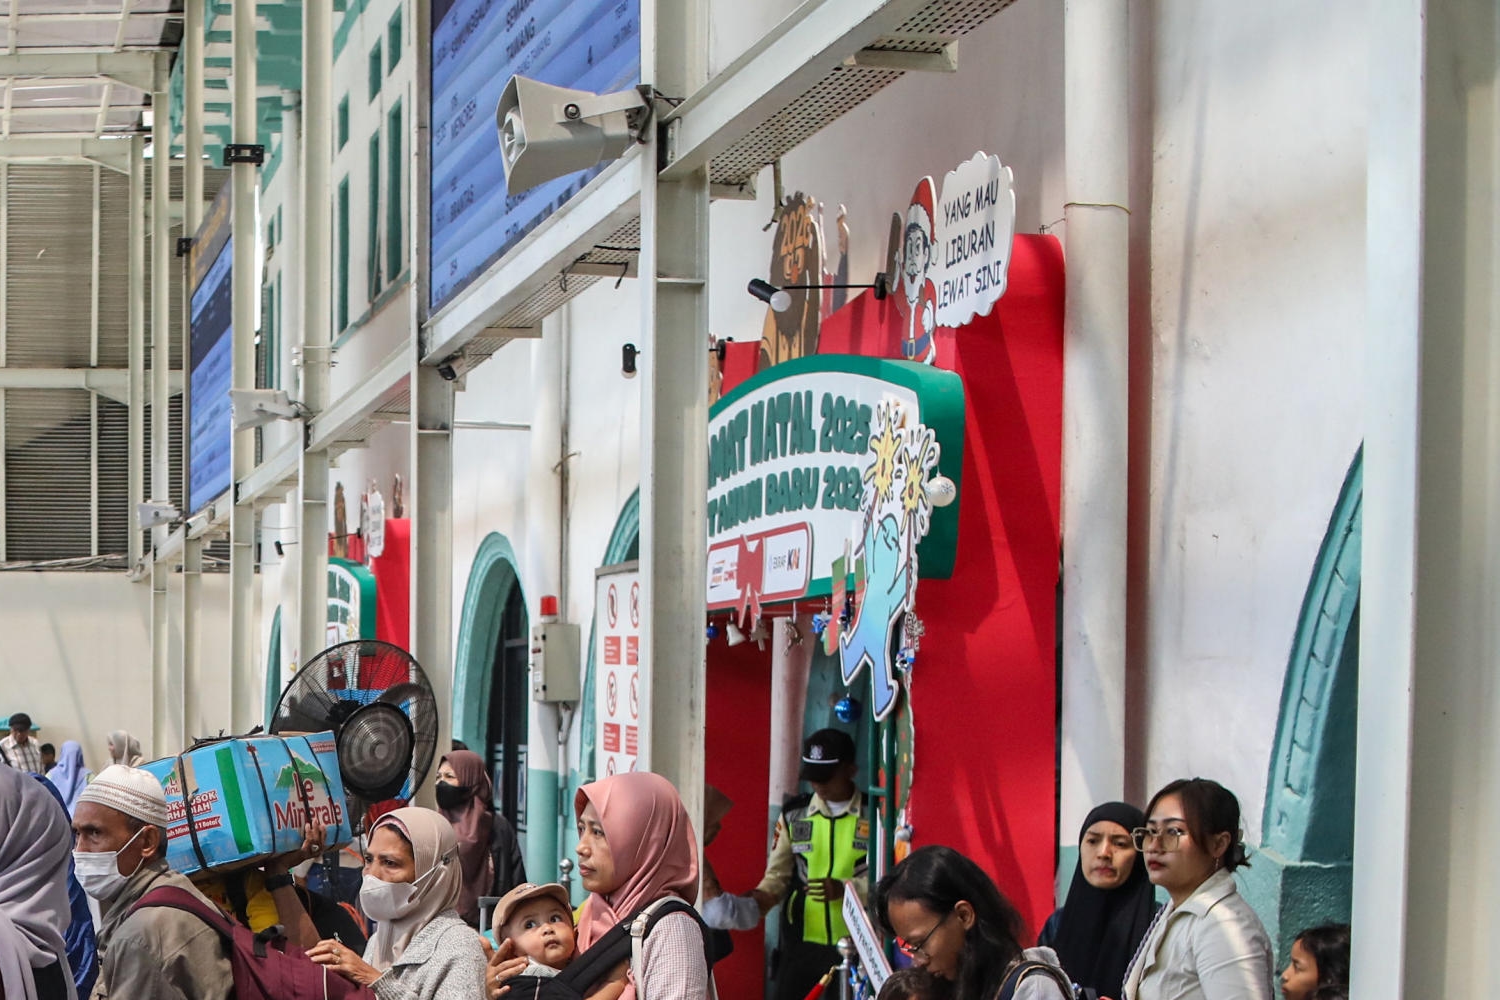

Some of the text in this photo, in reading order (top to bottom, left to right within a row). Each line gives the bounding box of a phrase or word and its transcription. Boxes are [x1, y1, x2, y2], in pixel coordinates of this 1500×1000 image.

[944, 178, 999, 228] YANG MAU
[945, 220, 996, 270] LIBURAN
[938, 260, 1002, 310] LEWAT SINI
[750, 389, 816, 467] NATAL
[819, 391, 873, 455] 2025
[765, 467, 820, 516] BARU
[293, 772, 315, 802] Le
[274, 795, 343, 830] Minerale
